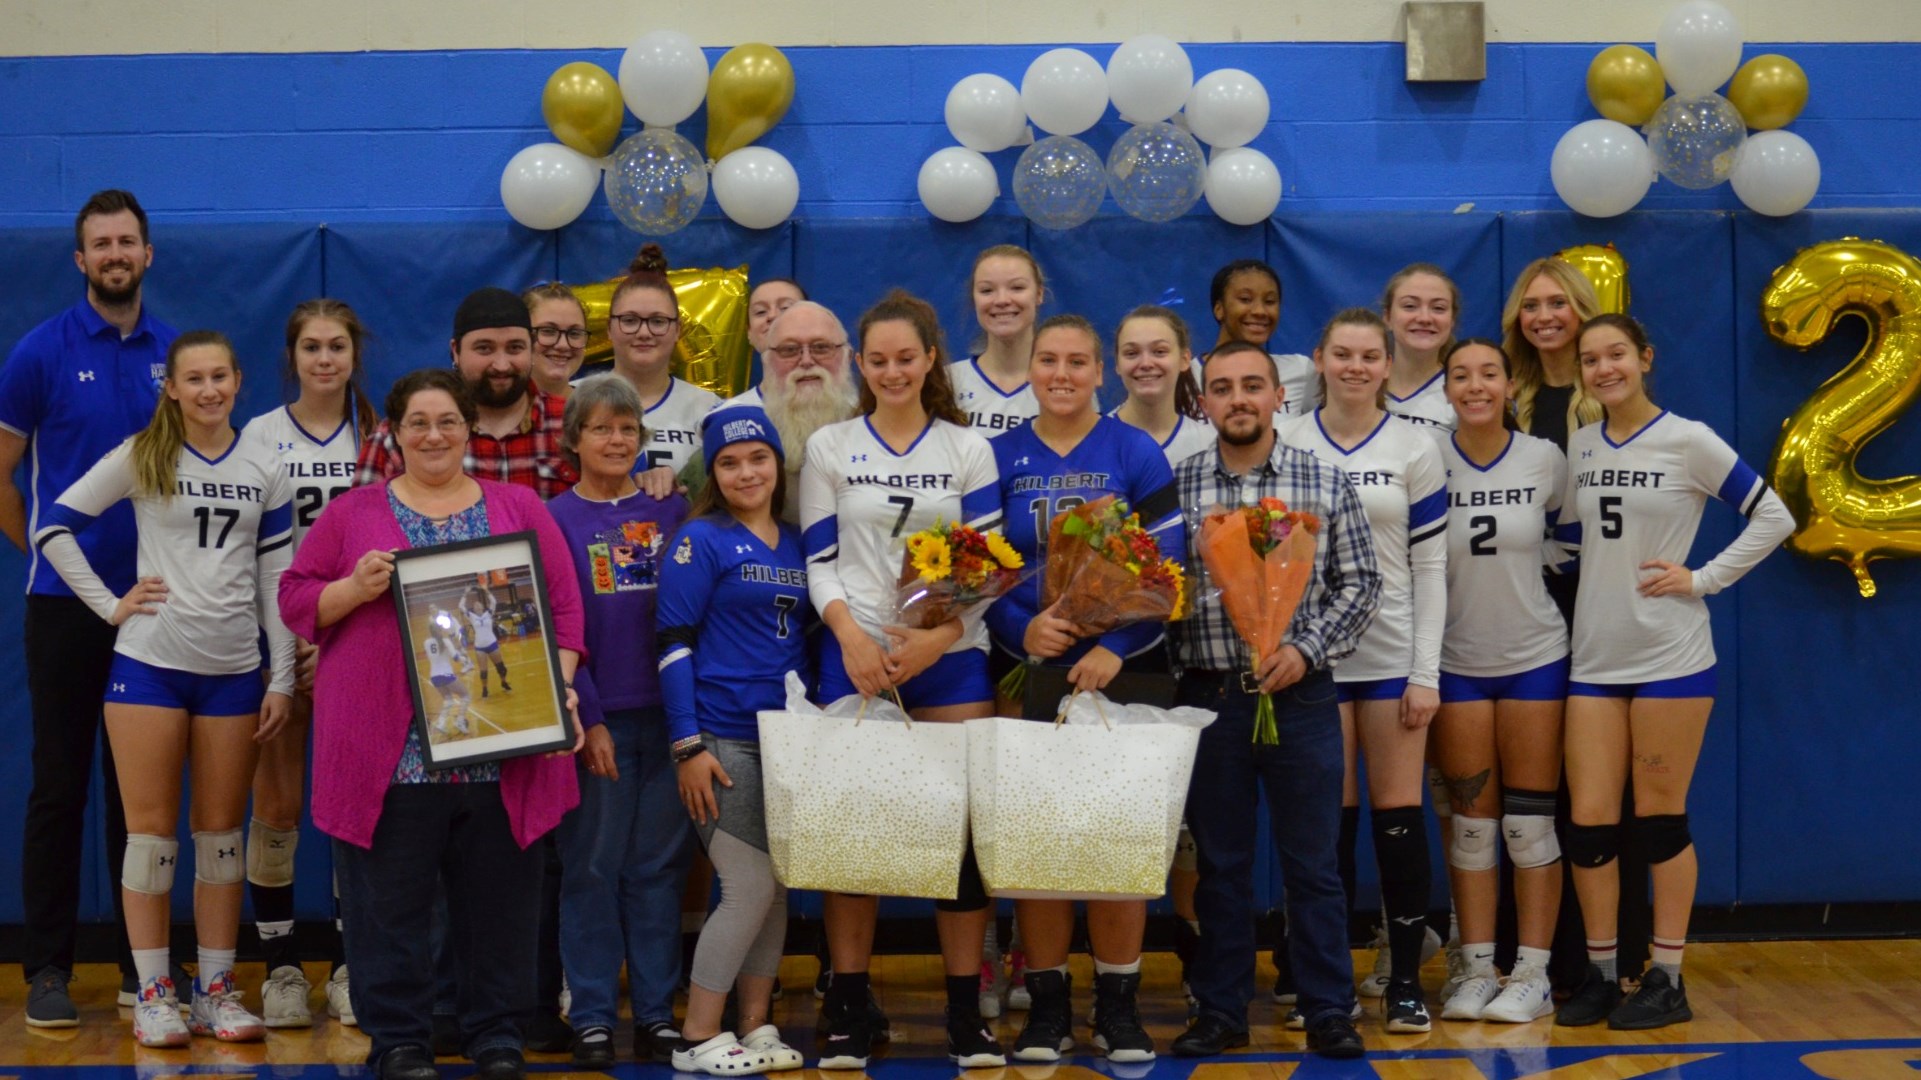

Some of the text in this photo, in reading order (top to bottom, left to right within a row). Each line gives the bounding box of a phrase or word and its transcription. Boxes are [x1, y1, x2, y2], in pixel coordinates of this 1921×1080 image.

[968, 411, 1025, 431] ILBE
[285, 462, 356, 478] ILBER
[847, 473, 953, 490] HILBERT
[1575, 469, 1665, 489] HILBERT
[159, 480, 263, 504] ILBERT
[1013, 472, 1110, 494] HILBERT
[296, 486, 351, 528] 2
[1447, 487, 1536, 508] ILBERT
[193, 505, 241, 549] 17
[888, 495, 914, 538] 7
[1599, 496, 1623, 540] 5
[1470, 515, 1497, 556] 2
[742, 563, 808, 589] HILBER
[774, 593, 799, 639] 7
